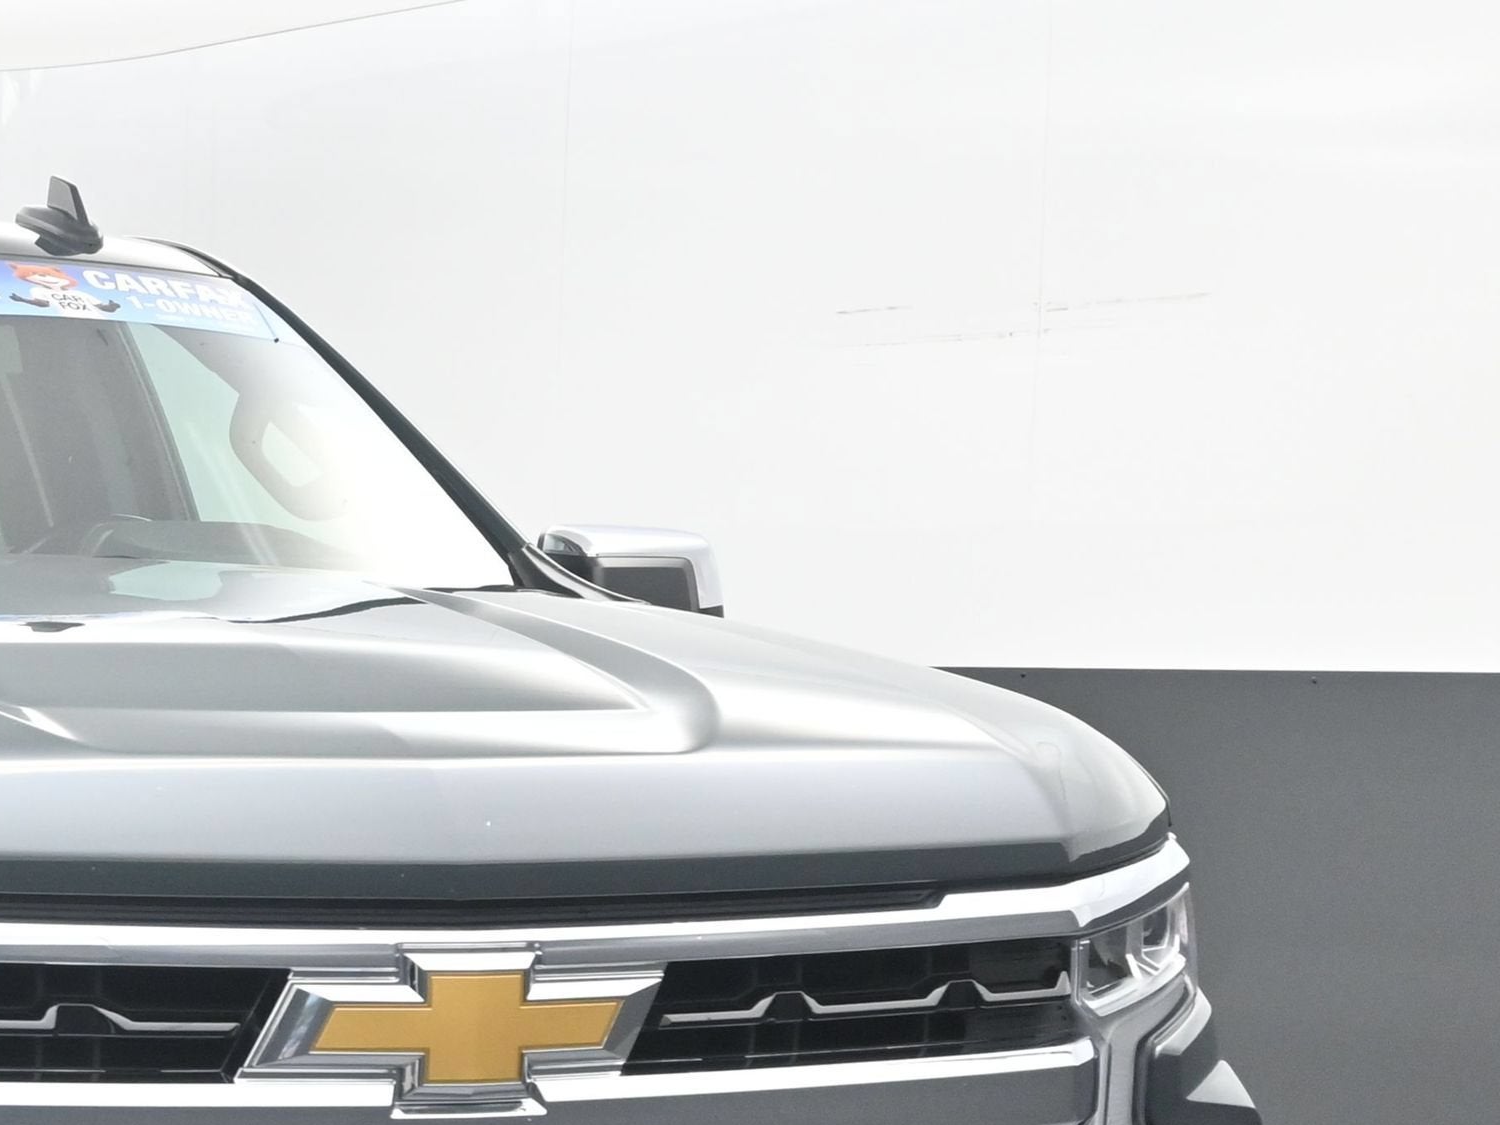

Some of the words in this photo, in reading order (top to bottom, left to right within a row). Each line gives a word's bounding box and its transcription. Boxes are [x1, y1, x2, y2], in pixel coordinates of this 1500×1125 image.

[51, 293, 84, 304] CAR
[82, 270, 249, 308] CARFAX
[59, 301, 92, 311] FOX
[125, 295, 254, 323] 1-OWNER
